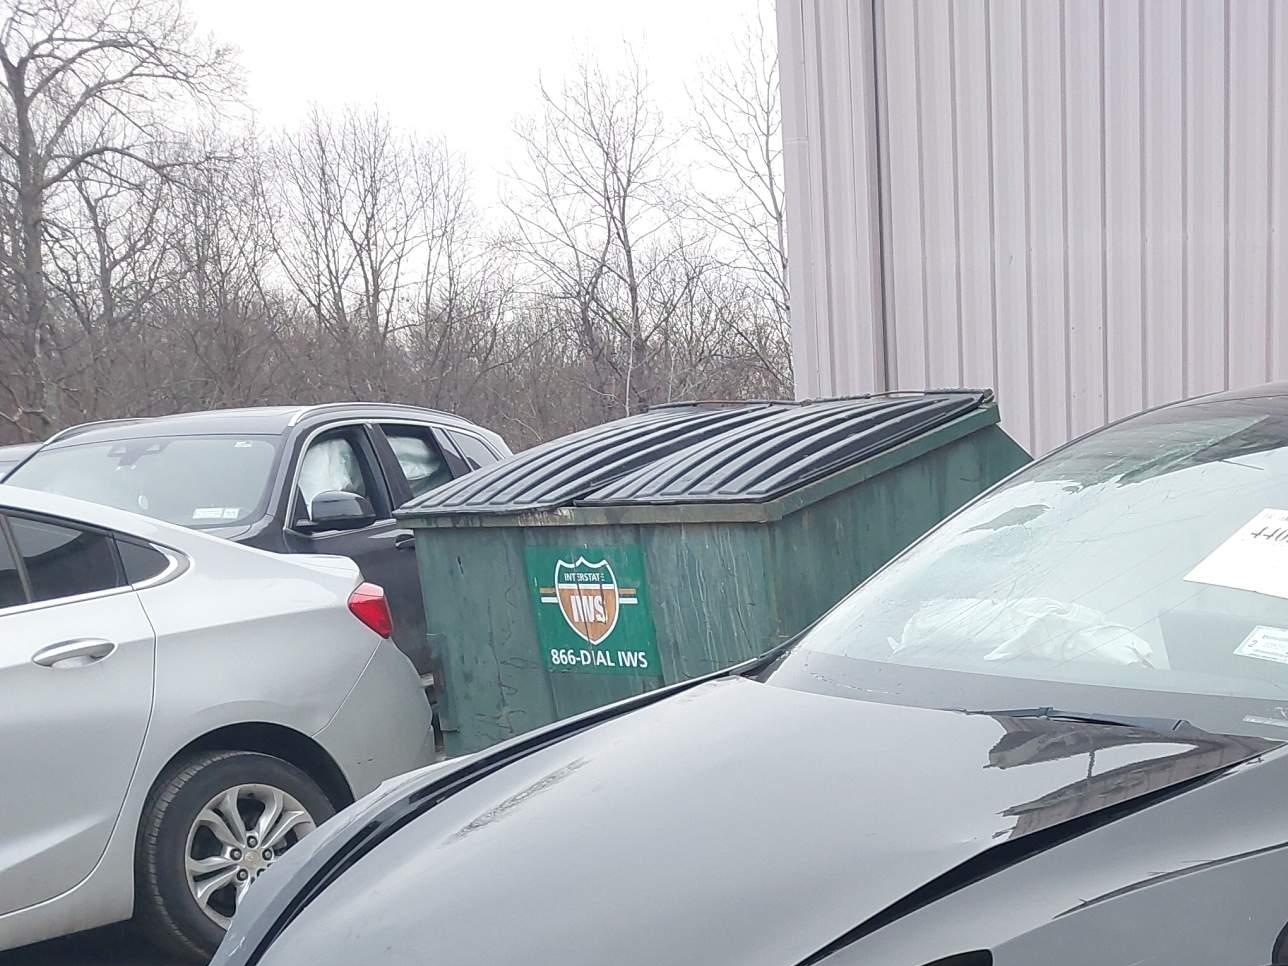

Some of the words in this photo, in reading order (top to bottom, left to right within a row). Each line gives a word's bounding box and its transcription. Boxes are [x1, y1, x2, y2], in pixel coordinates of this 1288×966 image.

[564, 572, 605, 583] INTERSTATE
[570, 594, 608, 625] IWS
[550, 648, 615, 668] 866-DIAL
[617, 650, 649, 669] IWS
